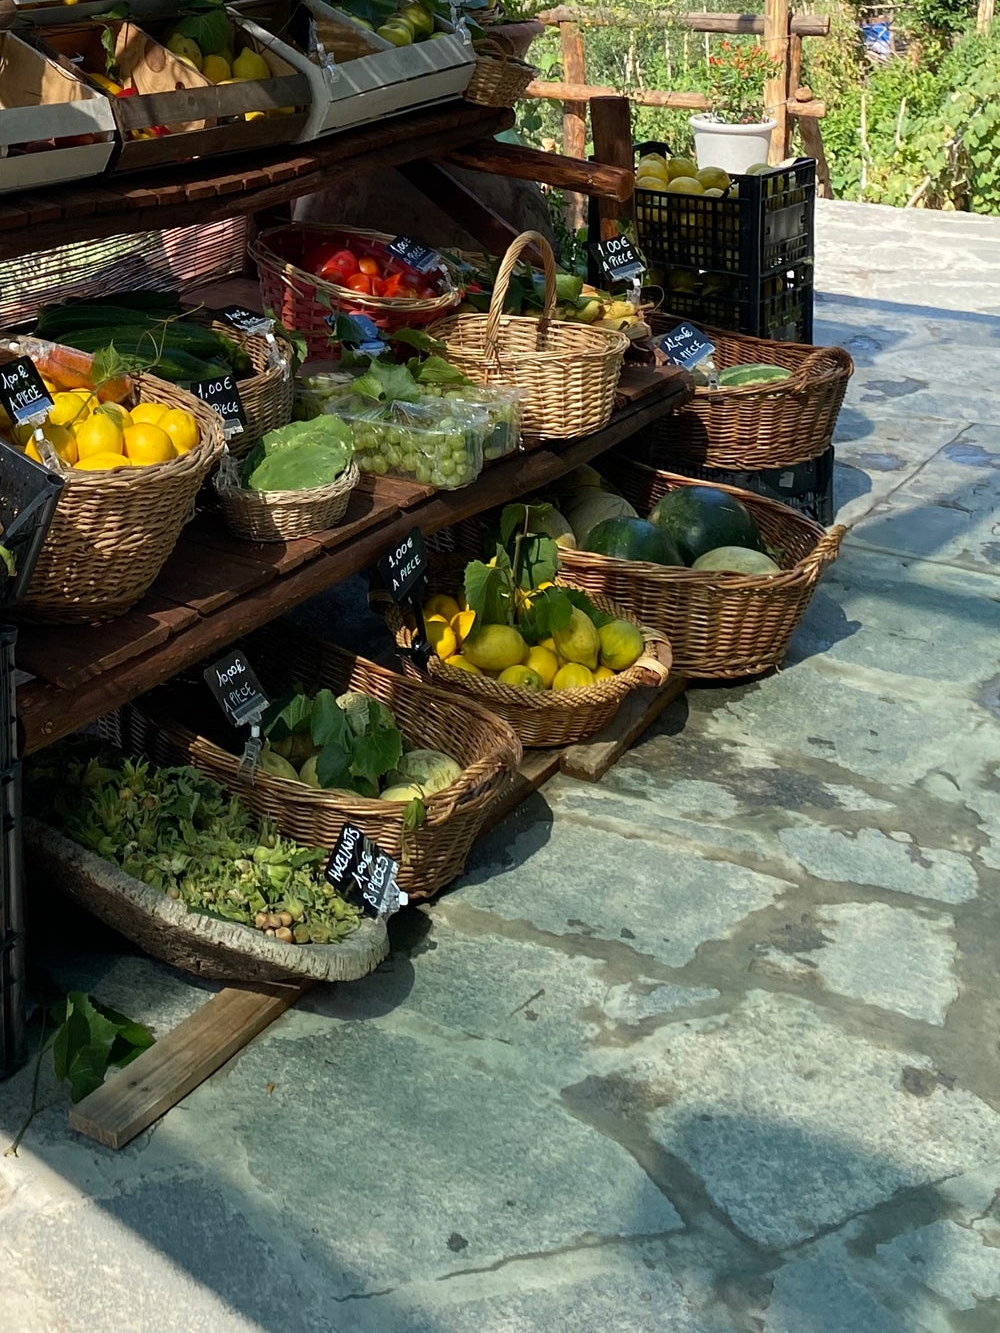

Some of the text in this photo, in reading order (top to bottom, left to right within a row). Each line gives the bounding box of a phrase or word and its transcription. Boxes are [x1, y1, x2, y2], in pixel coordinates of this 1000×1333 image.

[602, 261, 610, 272] A
[680, 340, 706, 360] PIECE
[16, 384, 43, 407] PIECE
[198, 376, 232, 400] 1,00€
[388, 537, 413, 568] 1,00€
[400, 554, 422, 582] PIECE
[229, 681, 256, 706] PIECE
[327, 827, 360, 882] HAZELNUTS
[363, 855, 388, 909] 8 PIECES
